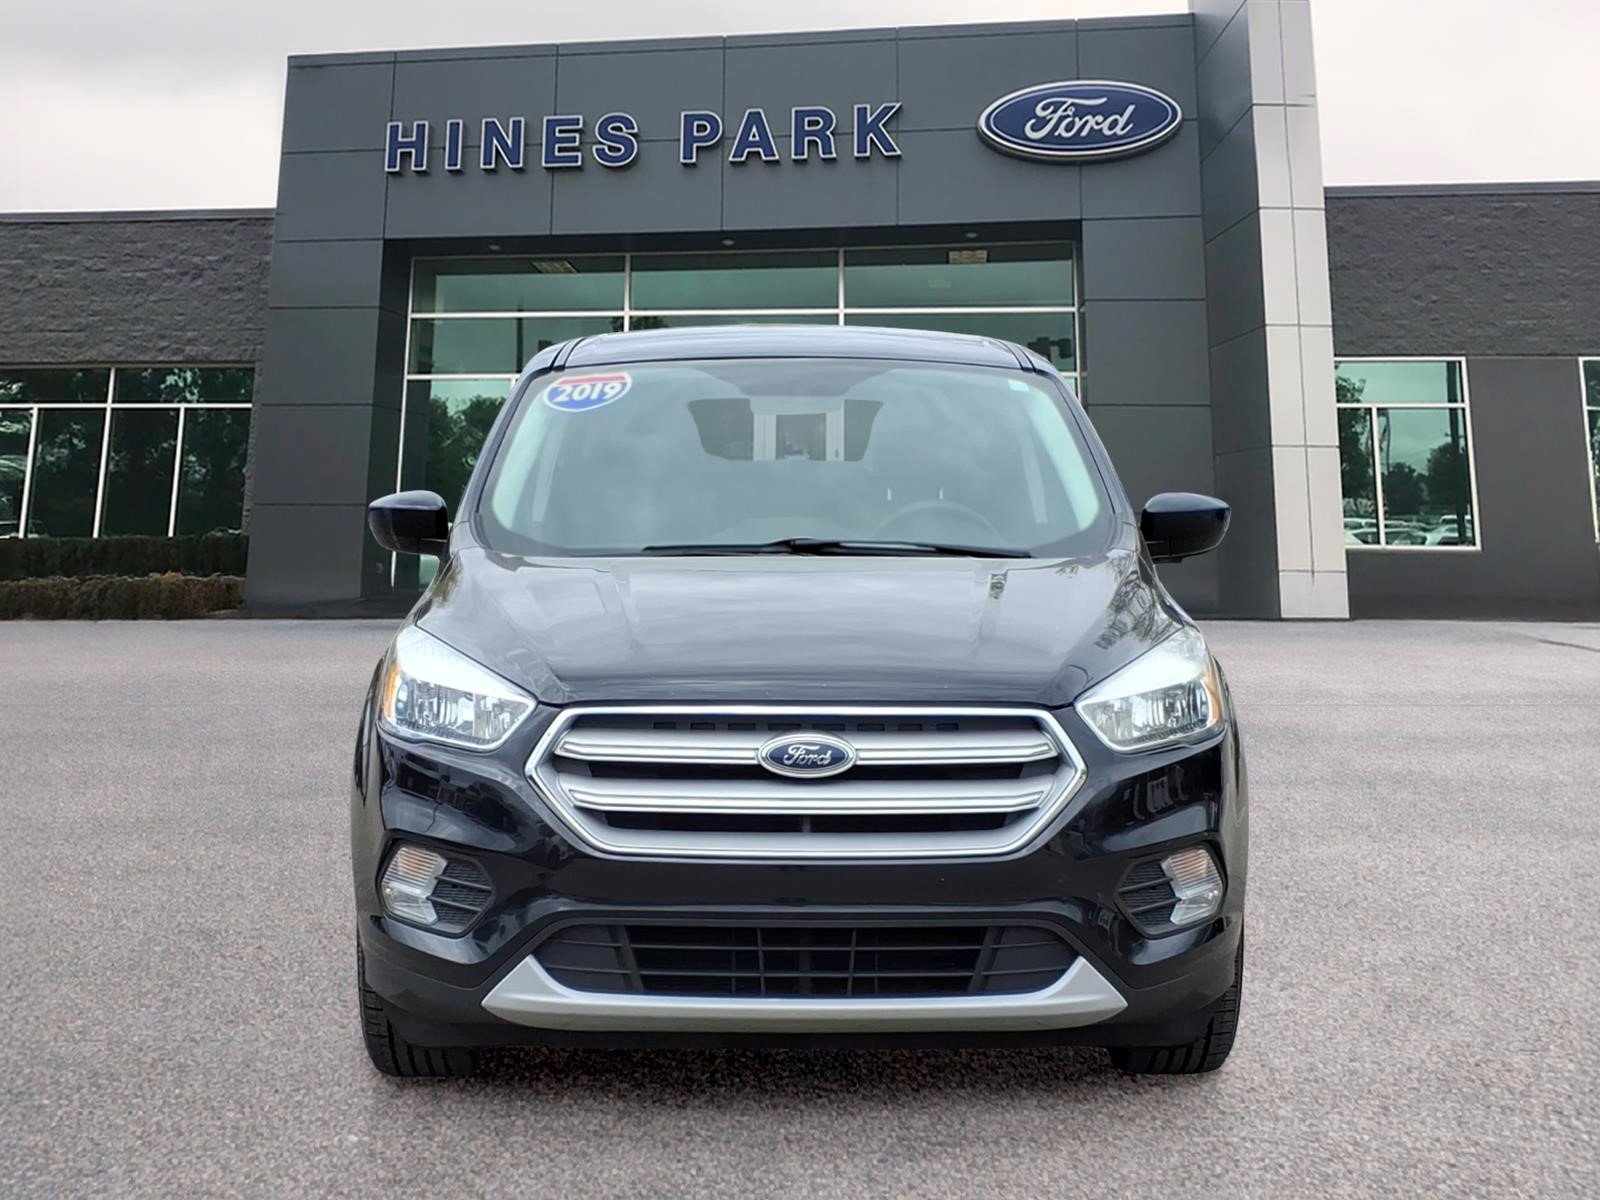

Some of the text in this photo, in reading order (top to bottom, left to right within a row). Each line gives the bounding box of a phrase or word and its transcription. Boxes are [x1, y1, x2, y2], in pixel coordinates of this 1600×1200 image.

[1024, 97, 1136, 140] Ford
[384, 102, 902, 173] HINES PARK
[552, 382, 622, 402] 2019
[783, 744, 832, 766] Ford
